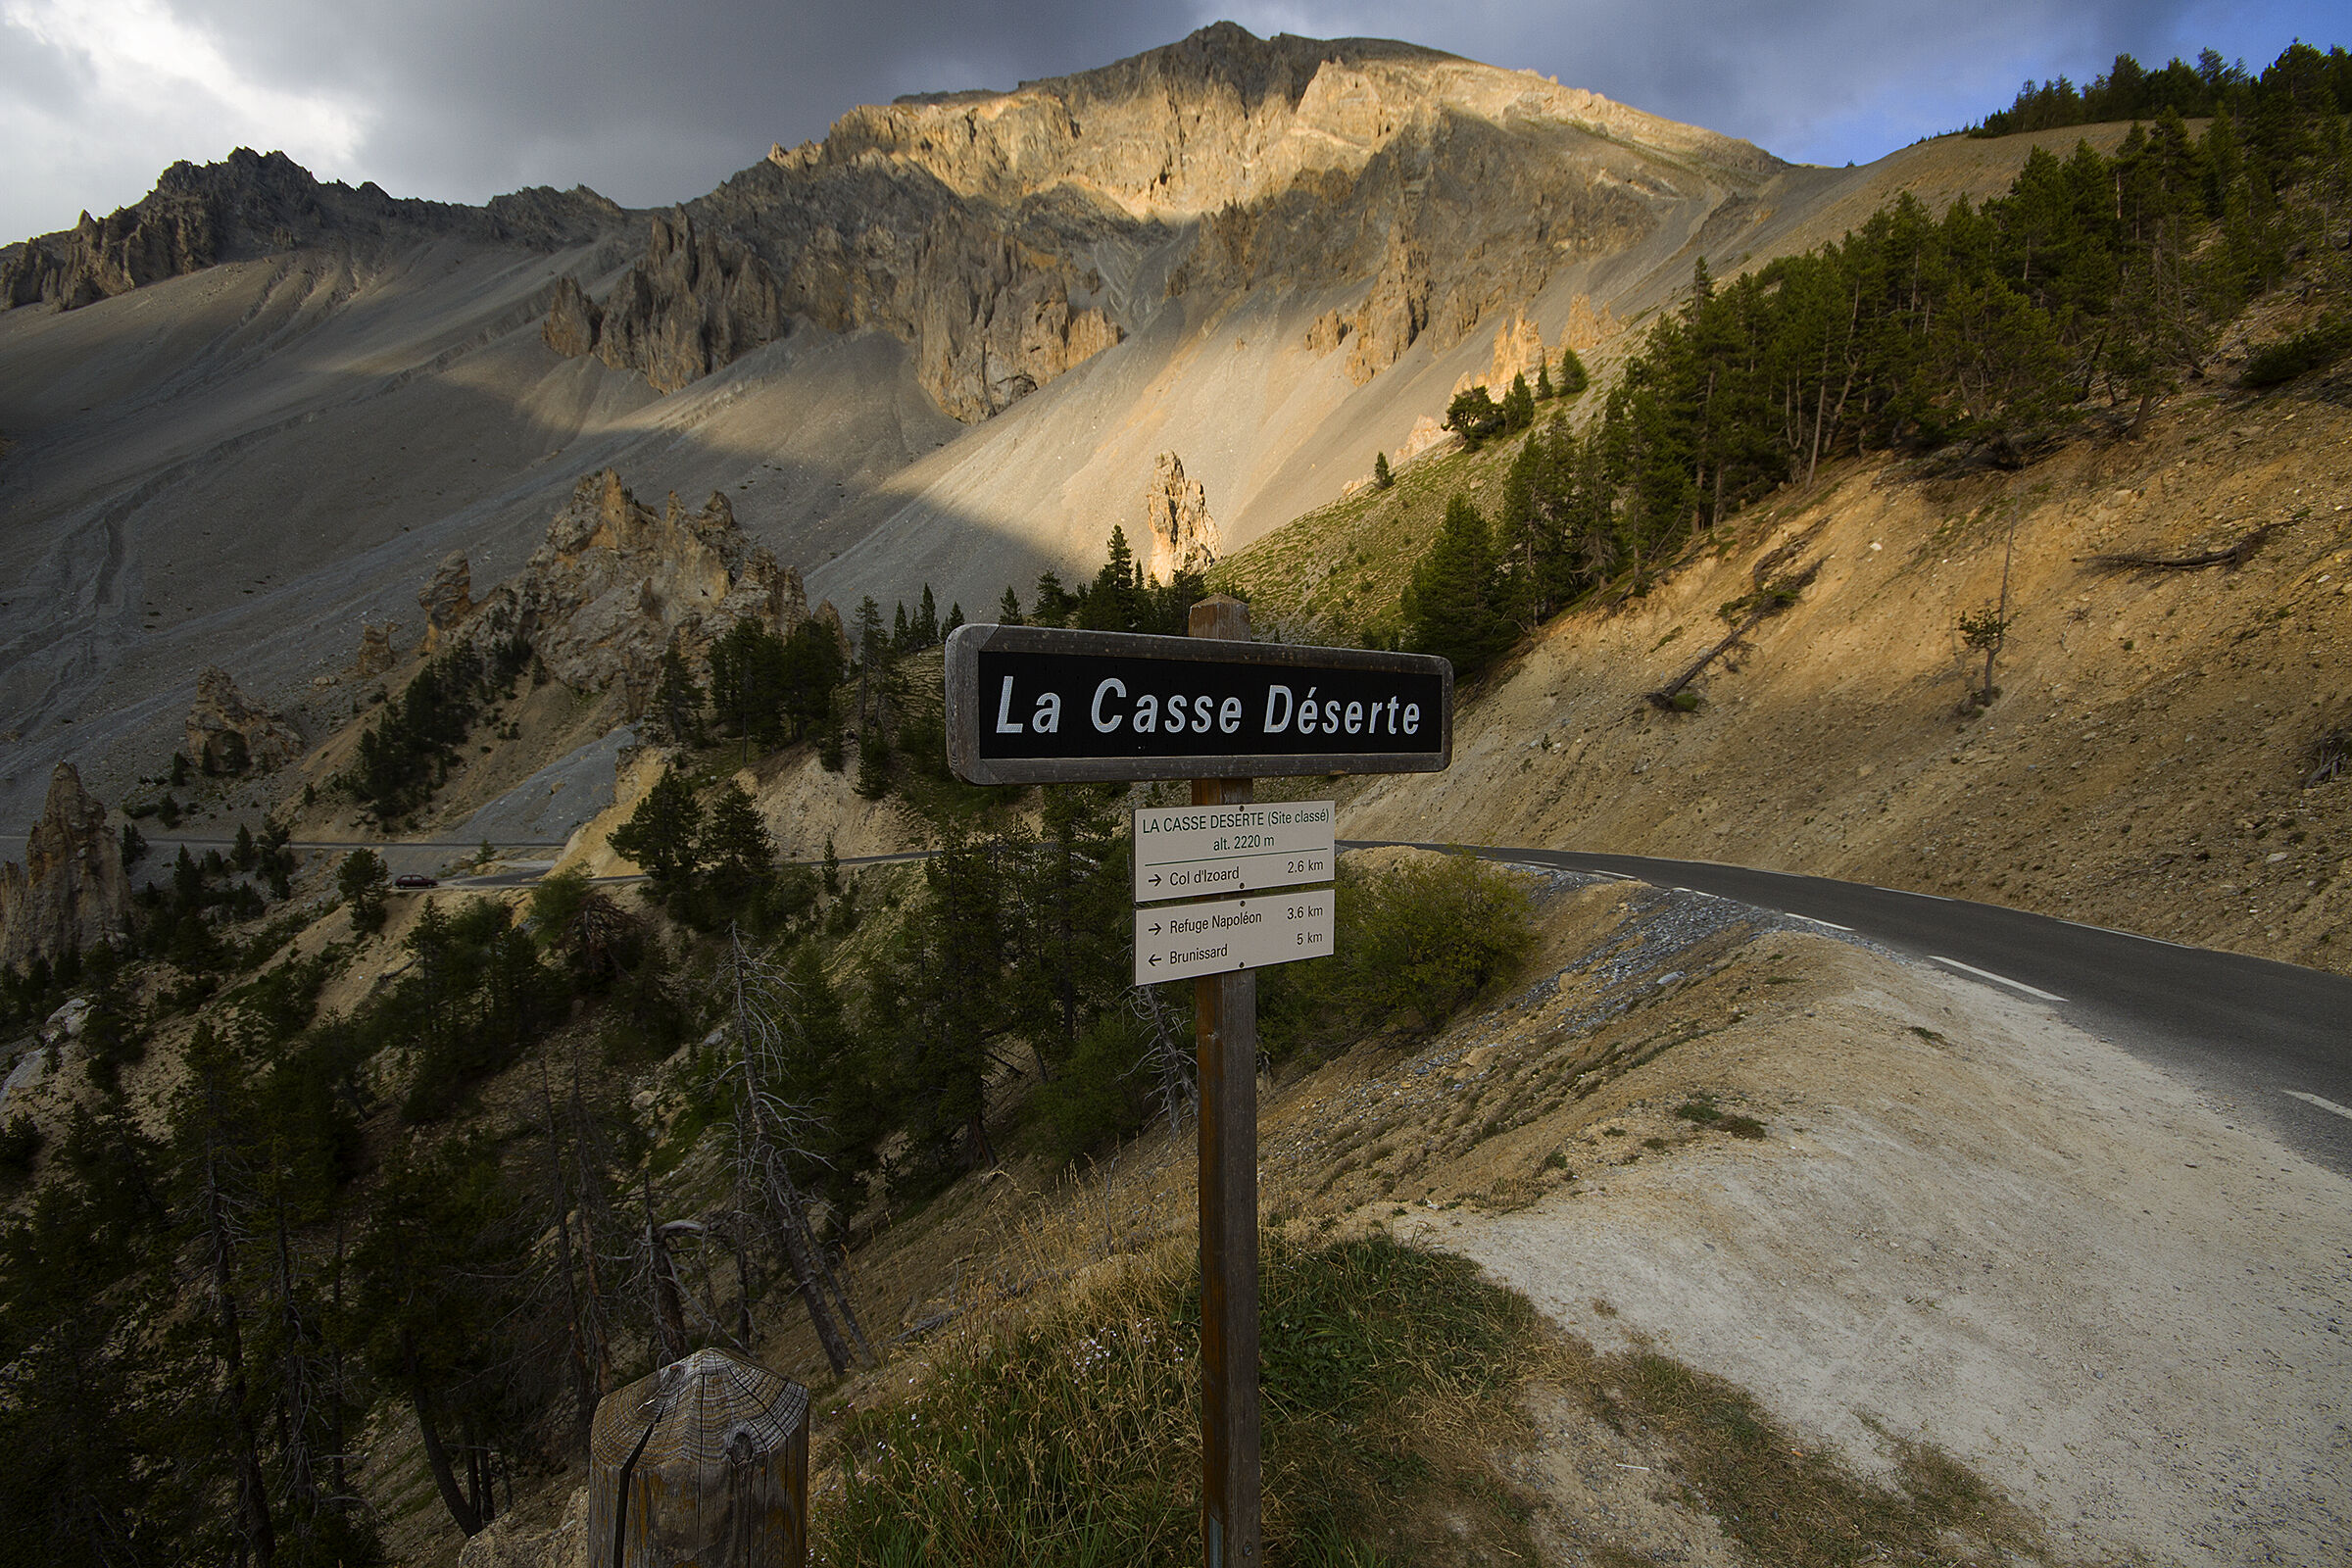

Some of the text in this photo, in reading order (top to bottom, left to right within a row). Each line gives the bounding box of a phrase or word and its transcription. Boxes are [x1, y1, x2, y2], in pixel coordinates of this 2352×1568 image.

[997, 675, 1421, 735] La Casse Déserte
[1143, 808, 1330, 834] LA CASSE DESERTE (Site classé)
[1213, 834, 1275, 852] alt. 2220 m
[1169, 858, 1324, 886] Col d'Izoard 2.6 km
[1169, 905, 1323, 934] Refuge Napoléon 3.6 km
[1169, 931, 1323, 964] Brunissard 5 km
